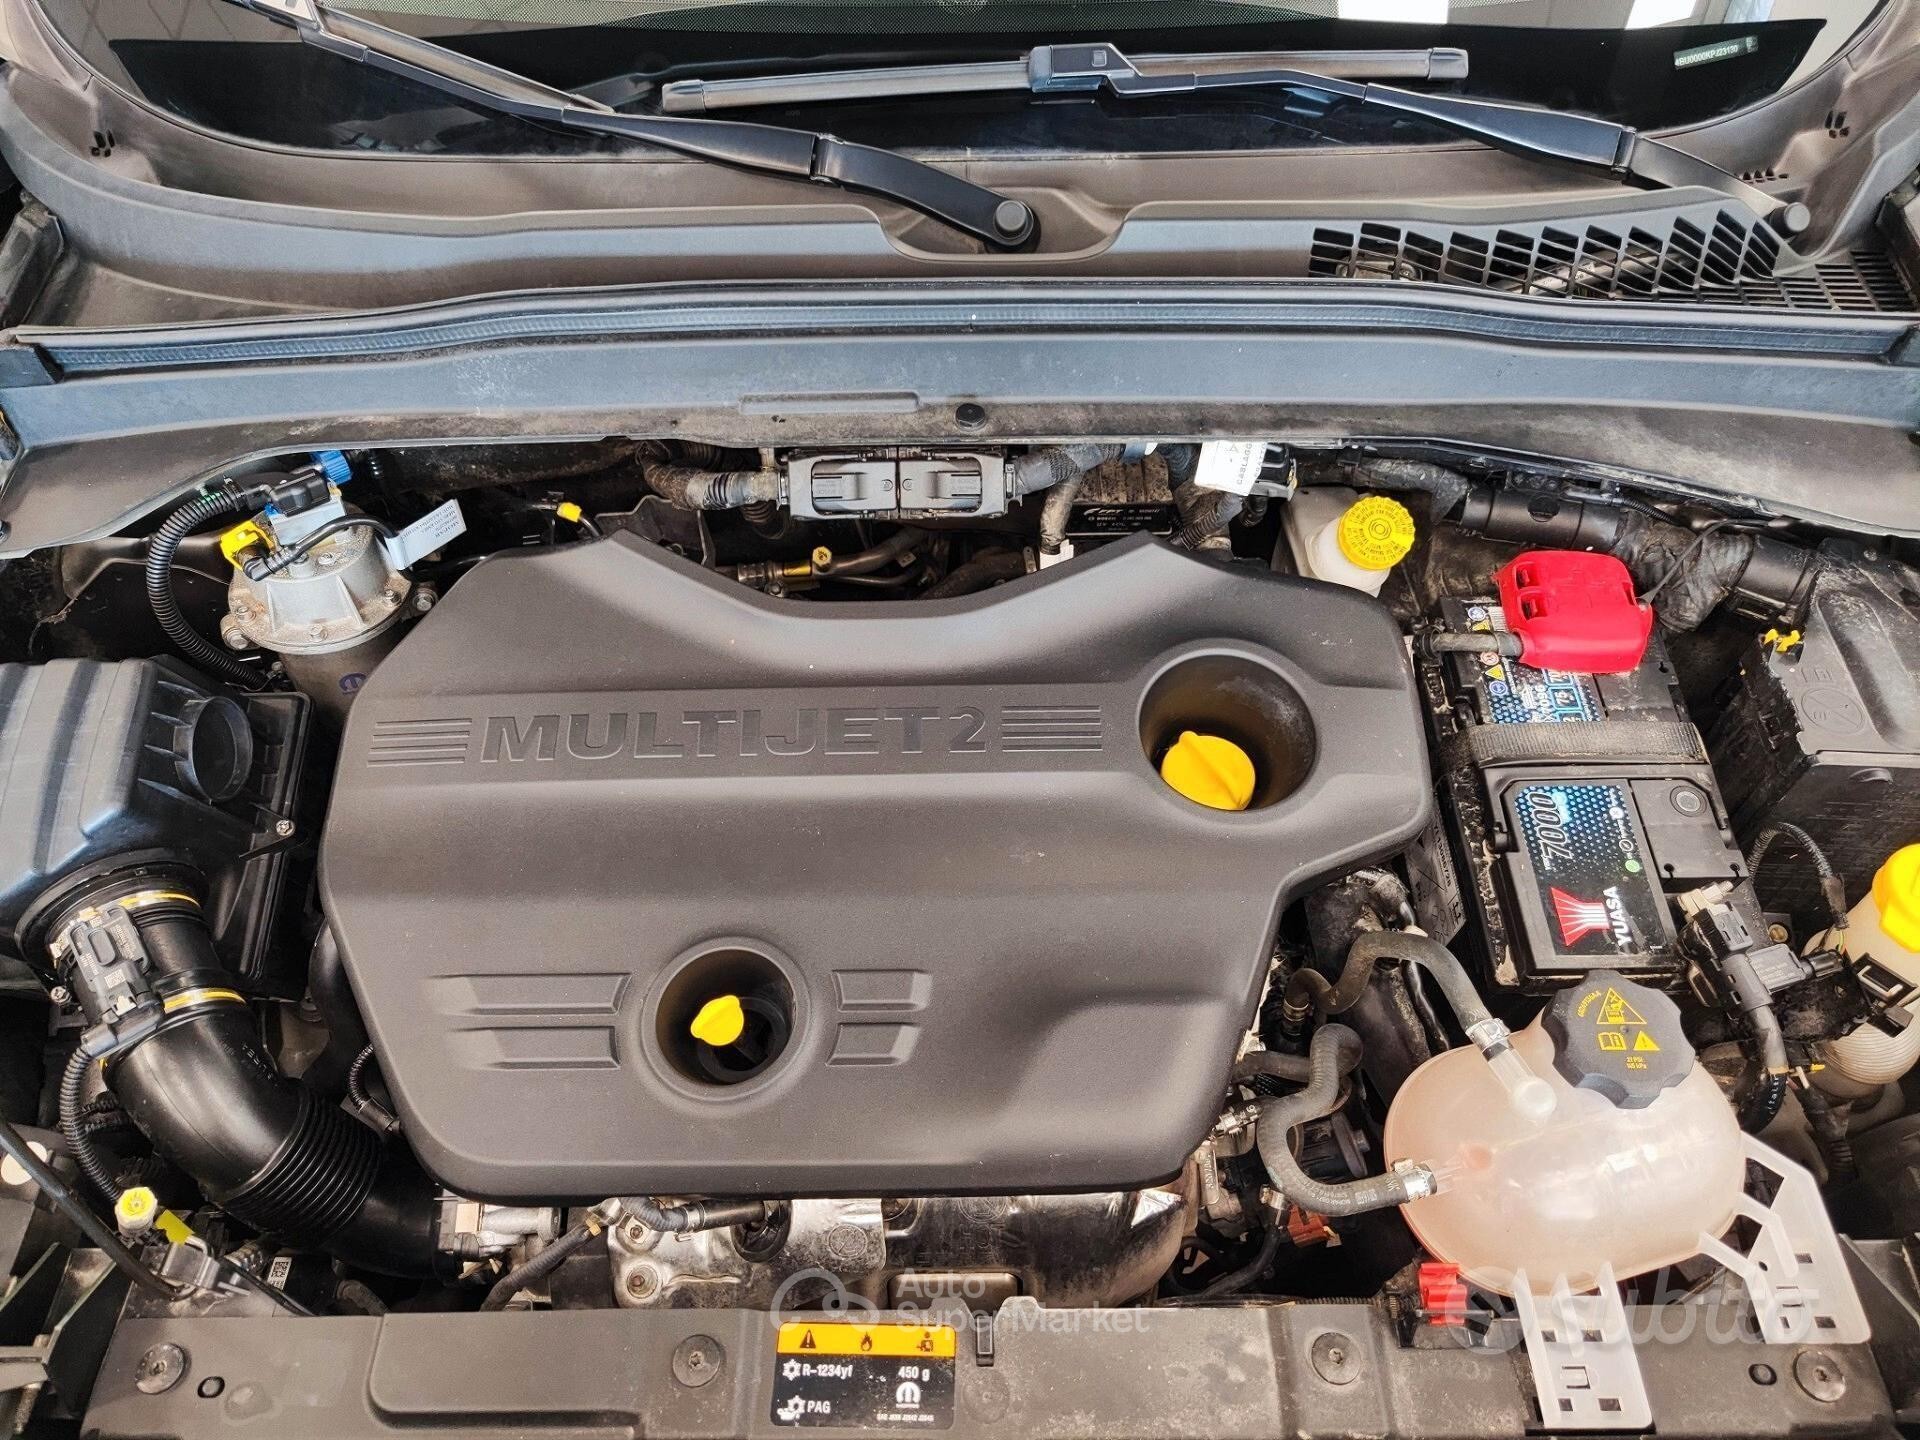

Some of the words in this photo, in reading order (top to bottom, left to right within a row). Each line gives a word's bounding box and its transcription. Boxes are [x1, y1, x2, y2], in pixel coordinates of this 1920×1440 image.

[1602, 886, 1633, 947] YUASA
[802, 1363, 853, 1380] R-1234yf
[898, 1365, 919, 1379] 450
[921, 1368, 931, 1382] g
[807, 1400, 831, 1414] PAG
